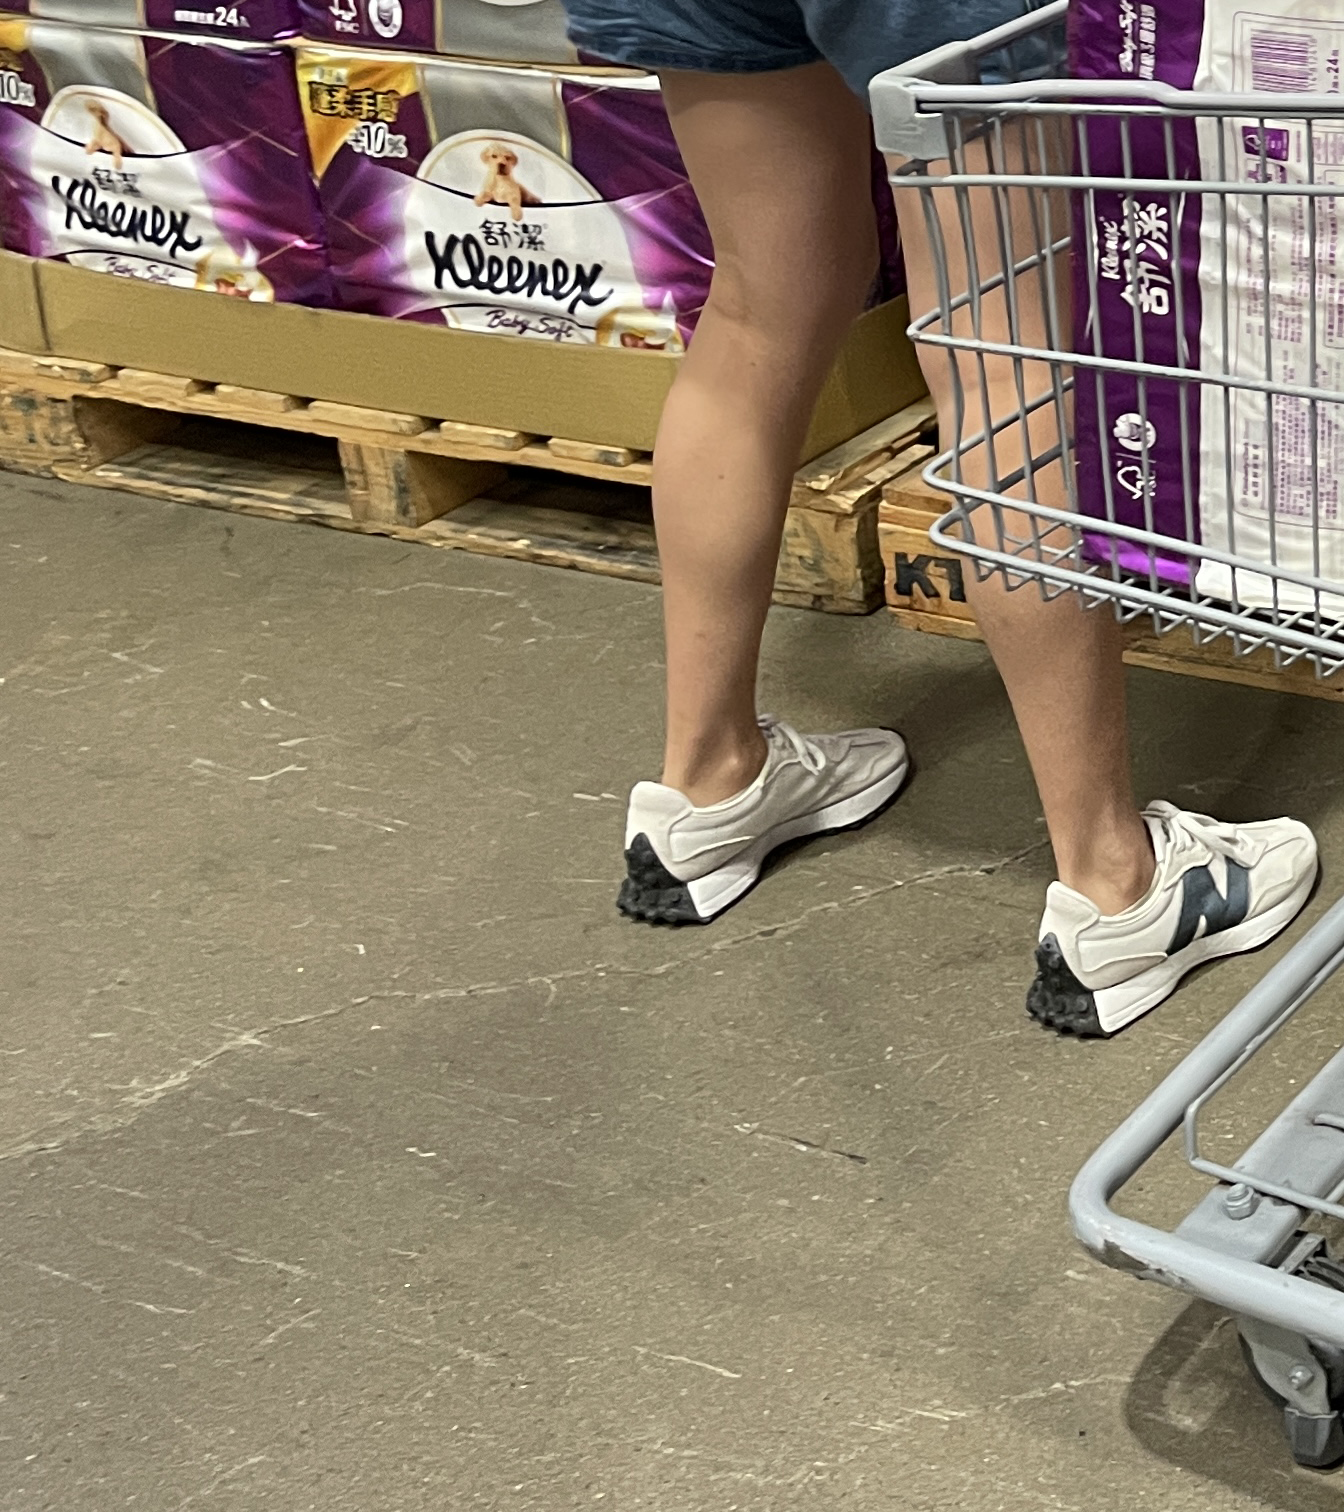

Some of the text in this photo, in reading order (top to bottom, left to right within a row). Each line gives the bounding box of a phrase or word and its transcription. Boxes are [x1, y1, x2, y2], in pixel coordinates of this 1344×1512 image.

[0, 69, 36, 108] 10%
[52, 176, 203, 257] Kleenex
[481, 218, 546, 251] 舒潔
[425, 231, 613, 314] Kleenex
